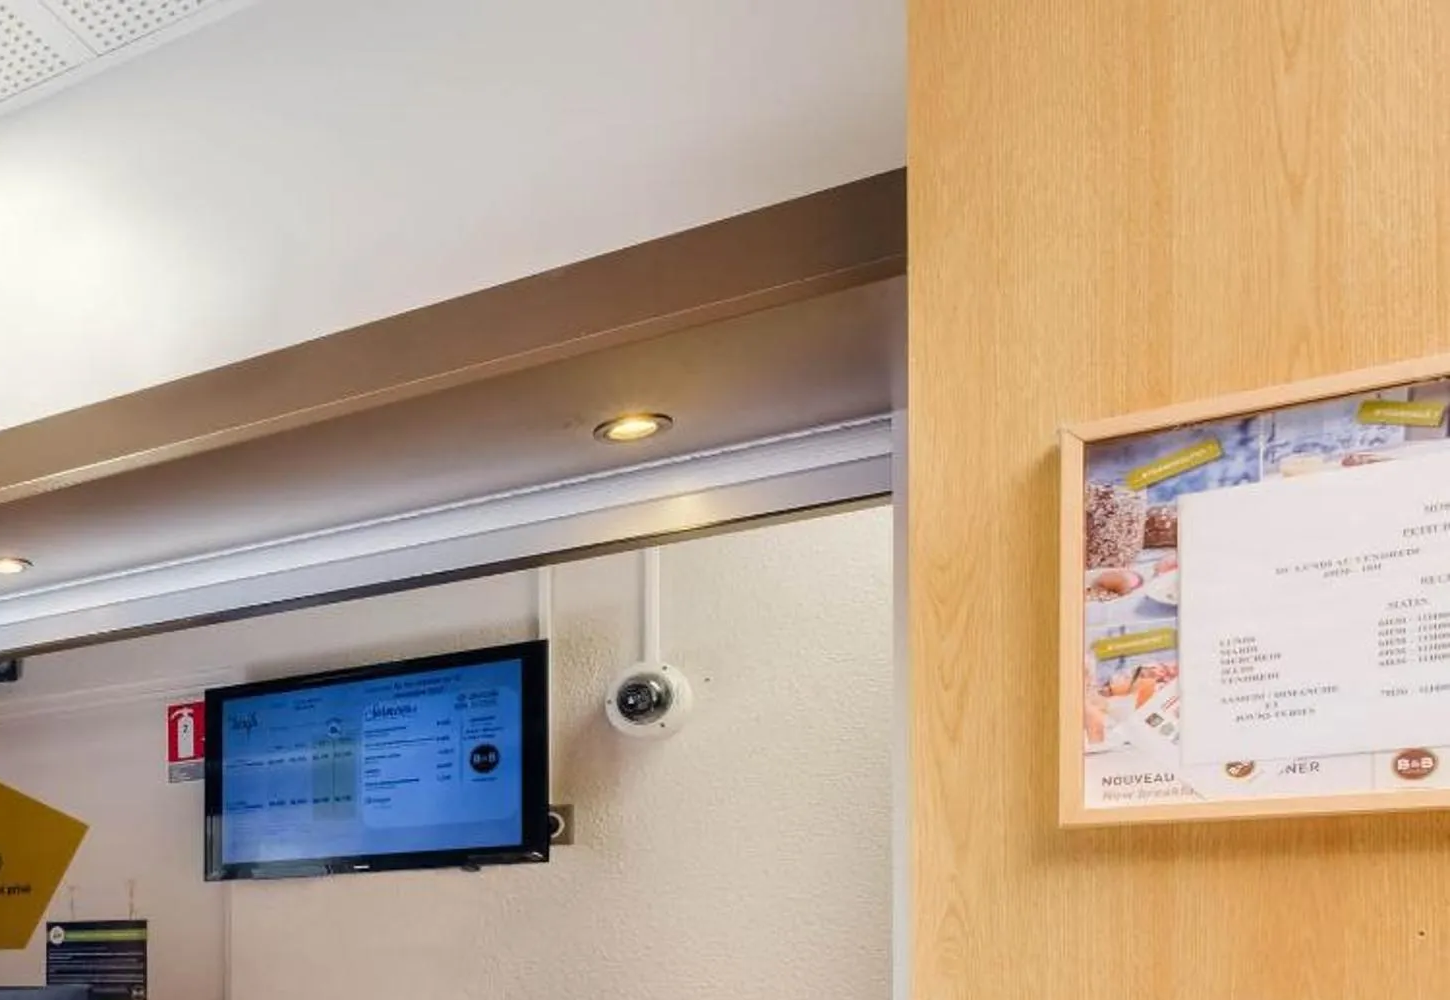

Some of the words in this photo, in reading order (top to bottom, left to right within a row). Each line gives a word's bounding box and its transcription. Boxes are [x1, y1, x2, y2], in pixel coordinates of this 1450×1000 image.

[1101, 772, 1175, 787] NOUVEAU
[1281, 760, 1320, 775] NER
[1397, 757, 1434, 771] B&B
